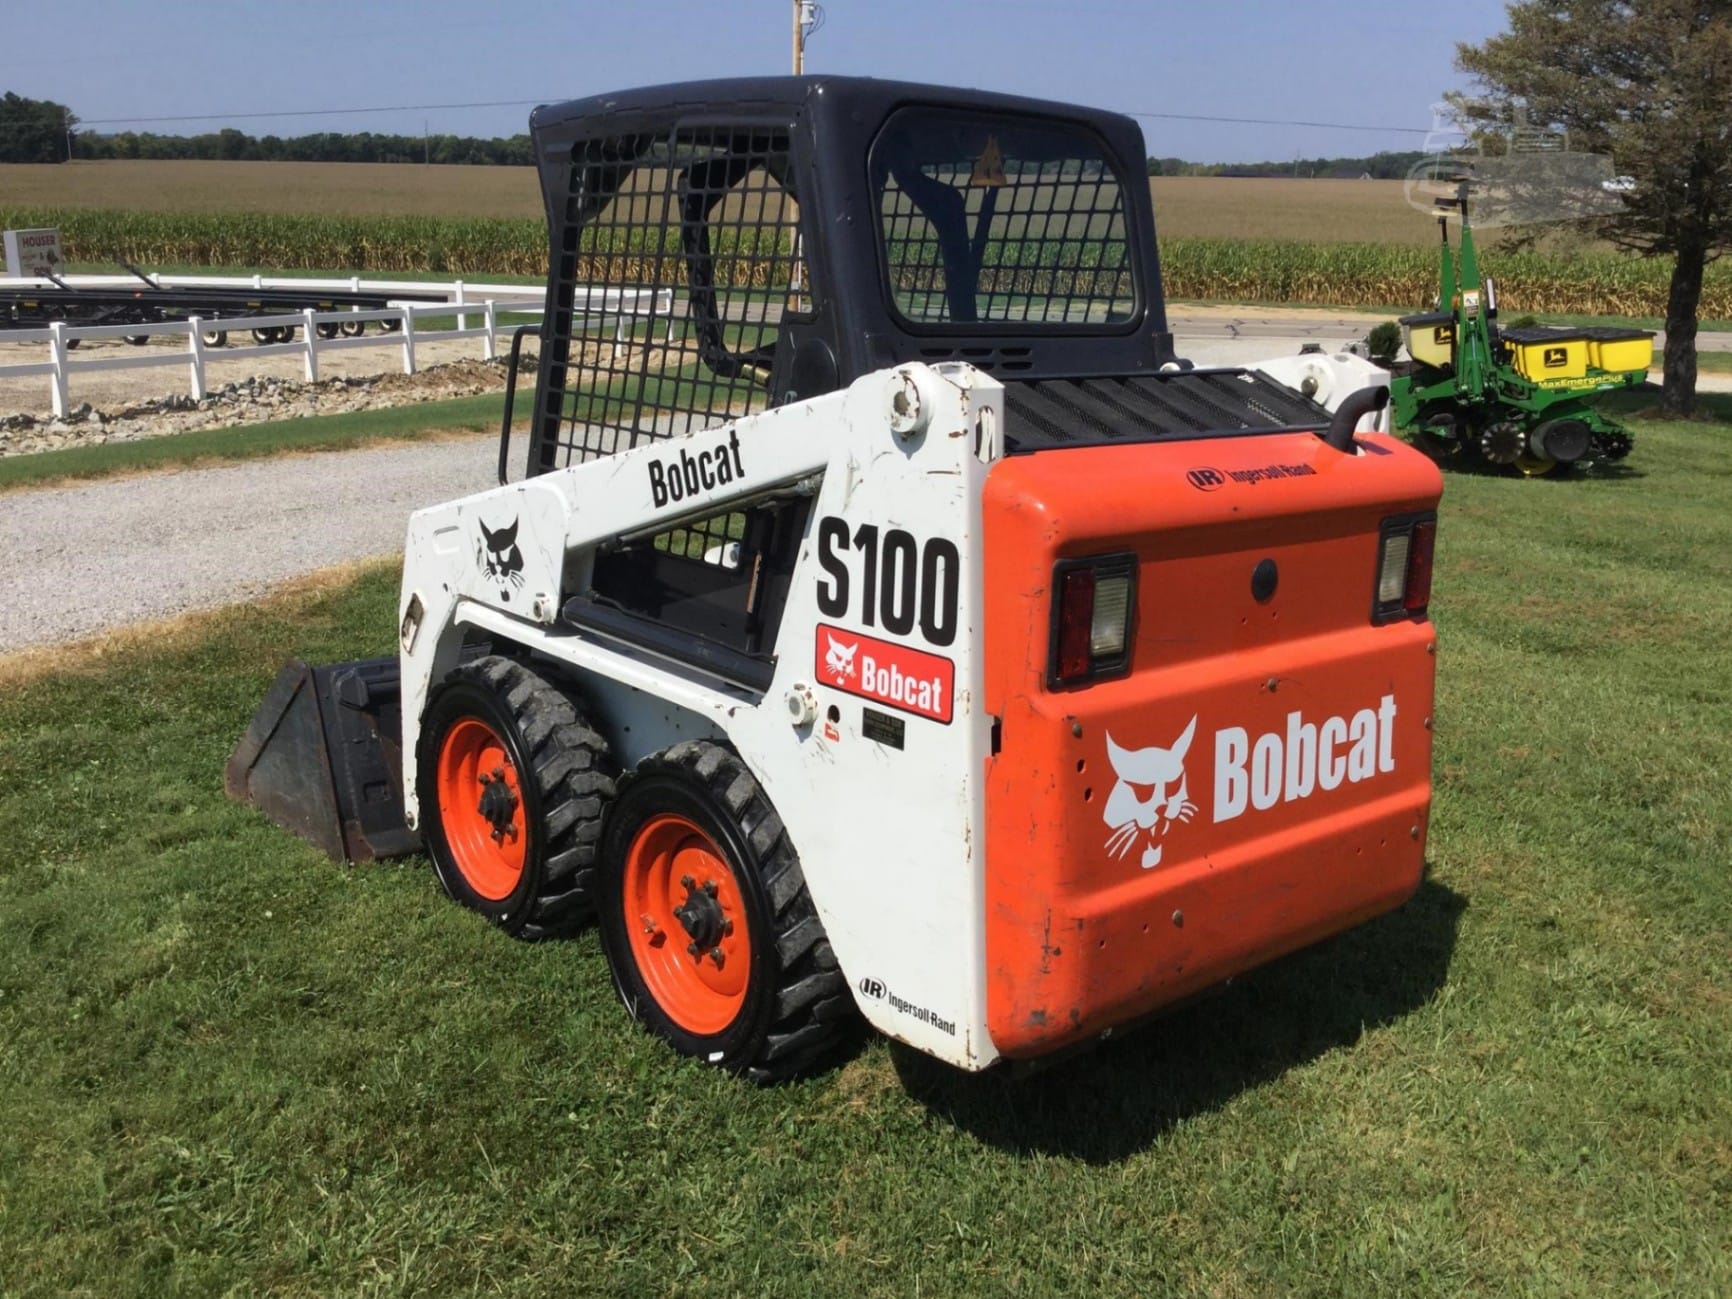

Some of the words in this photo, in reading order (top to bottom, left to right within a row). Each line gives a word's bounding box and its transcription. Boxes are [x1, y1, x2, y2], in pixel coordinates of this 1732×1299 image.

[22, 235, 56, 248] HOUSER
[648, 430, 745, 508] Bobcat
[816, 517, 959, 646] S100
[861, 656, 942, 711] Bobcat
[1213, 695, 1397, 824] Bobcat
[862, 977, 884, 999] IR
